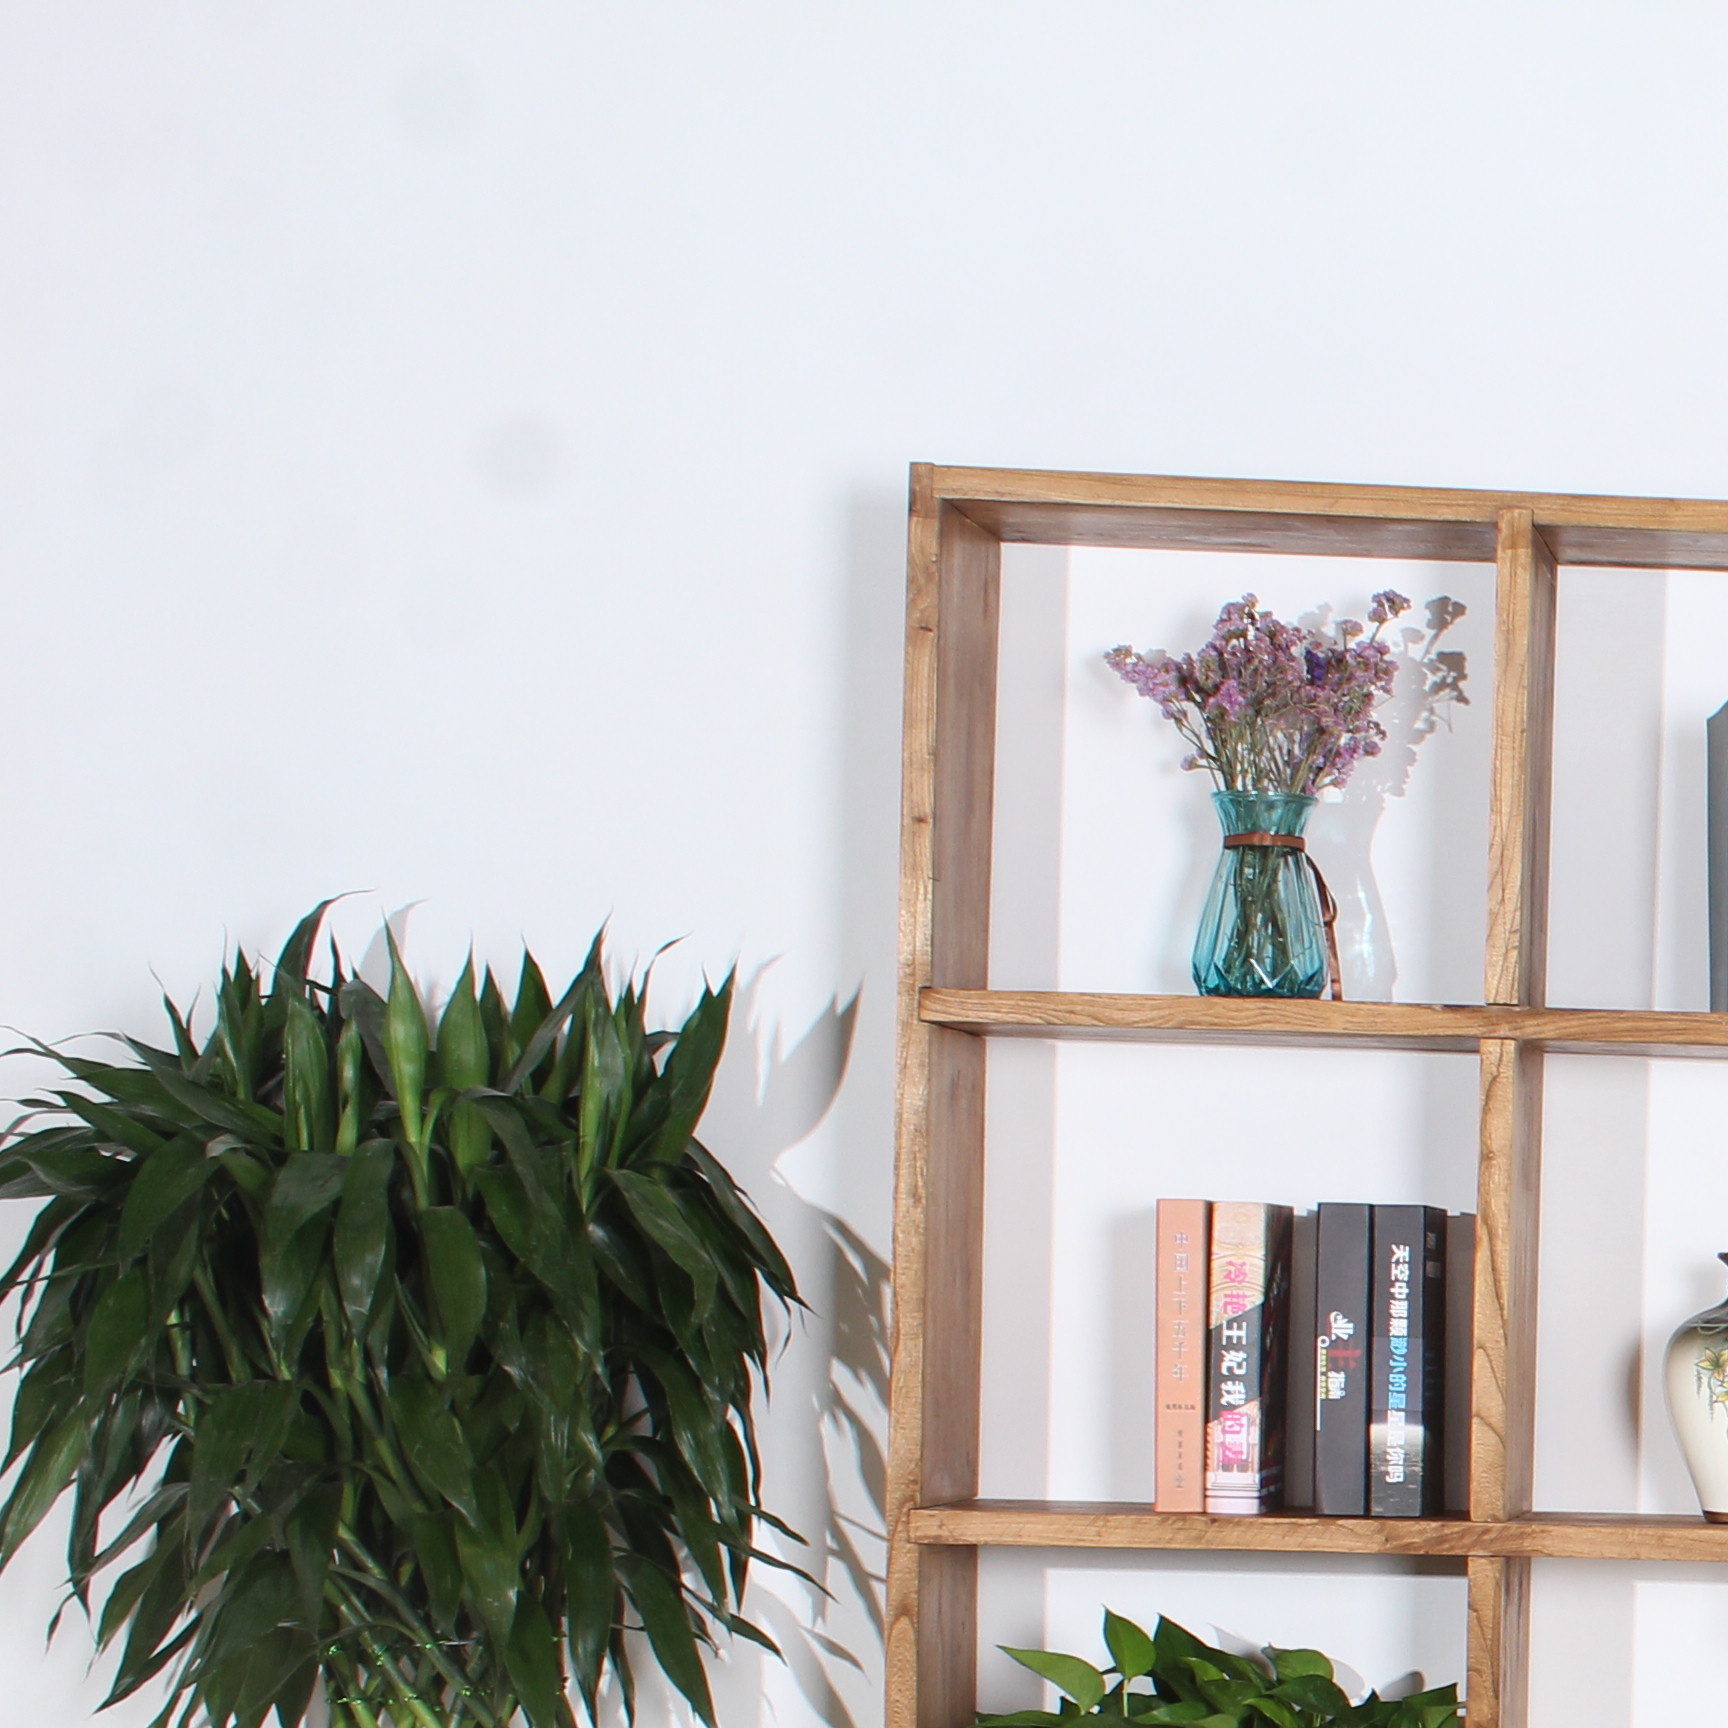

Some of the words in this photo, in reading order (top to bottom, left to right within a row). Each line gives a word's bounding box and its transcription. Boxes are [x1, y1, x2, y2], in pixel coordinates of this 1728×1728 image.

[1172, 1230, 1190, 1384] 中国上下五千年
[1385, 1244, 1410, 1484] 天空中那颗渺小的星星是你吗
